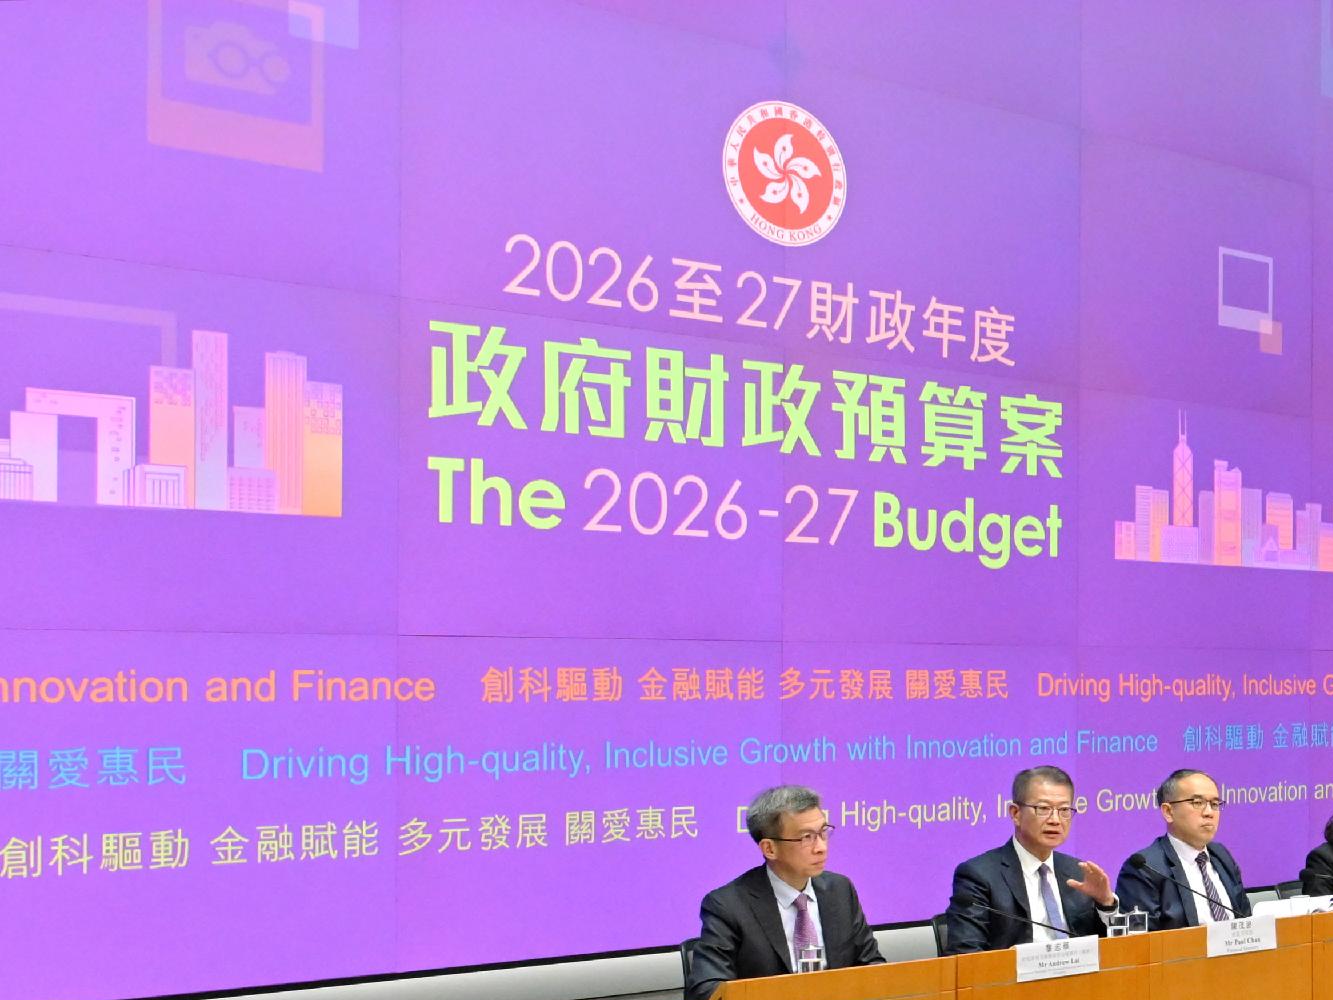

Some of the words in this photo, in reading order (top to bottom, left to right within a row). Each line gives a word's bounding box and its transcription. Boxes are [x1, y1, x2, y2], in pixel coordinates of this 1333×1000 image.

[750, 213, 784, 239] HONG
[789, 224, 822, 241] KONG
[502, 233, 1016, 367] 2026至27財政年度
[427, 319, 1063, 478] 政府財政預算案
[427, 455, 566, 530] The
[583, 468, 859, 546] 2026-27
[873, 490, 1063, 570] Budget
[204, 669, 277, 703] and
[290, 668, 437, 702] Finance
[480, 665, 624, 704] 創科驅動
[637, 666, 766, 702] 金融賦能
[779, 666, 893, 701] 多元發展
[905, 668, 1010, 701] 關愛惠民
[1037, 672, 1111, 703] Driving
[1118, 672, 1236, 703] High-quality,
[1243, 672, 1317, 697] Inclusive
[1183, 724, 1264, 752] 創科驅動
[0, 746, 187, 790] 關愛惠民
[241, 748, 369, 784] Driving
[385, 742, 591, 783] High-quality,
[605, 739, 728, 769] Inclusive
[739, 736, 836, 765] Growth
[847, 735, 895, 761] with
[906, 732, 1022, 760] Innovation
[1029, 732, 1068, 756] and
[1076, 730, 1158, 753] Finance
[1096, 788, 1158, 812] Growt
[1221, 782, 1307, 804] Innovation
[841, 796, 987, 832] High-quality,
[0, 828, 189, 879] 創科驅動
[210, 819, 379, 866] 金融賦能
[398, 814, 549, 856] 多元發展
[565, 805, 698, 846] 關愛惠民
